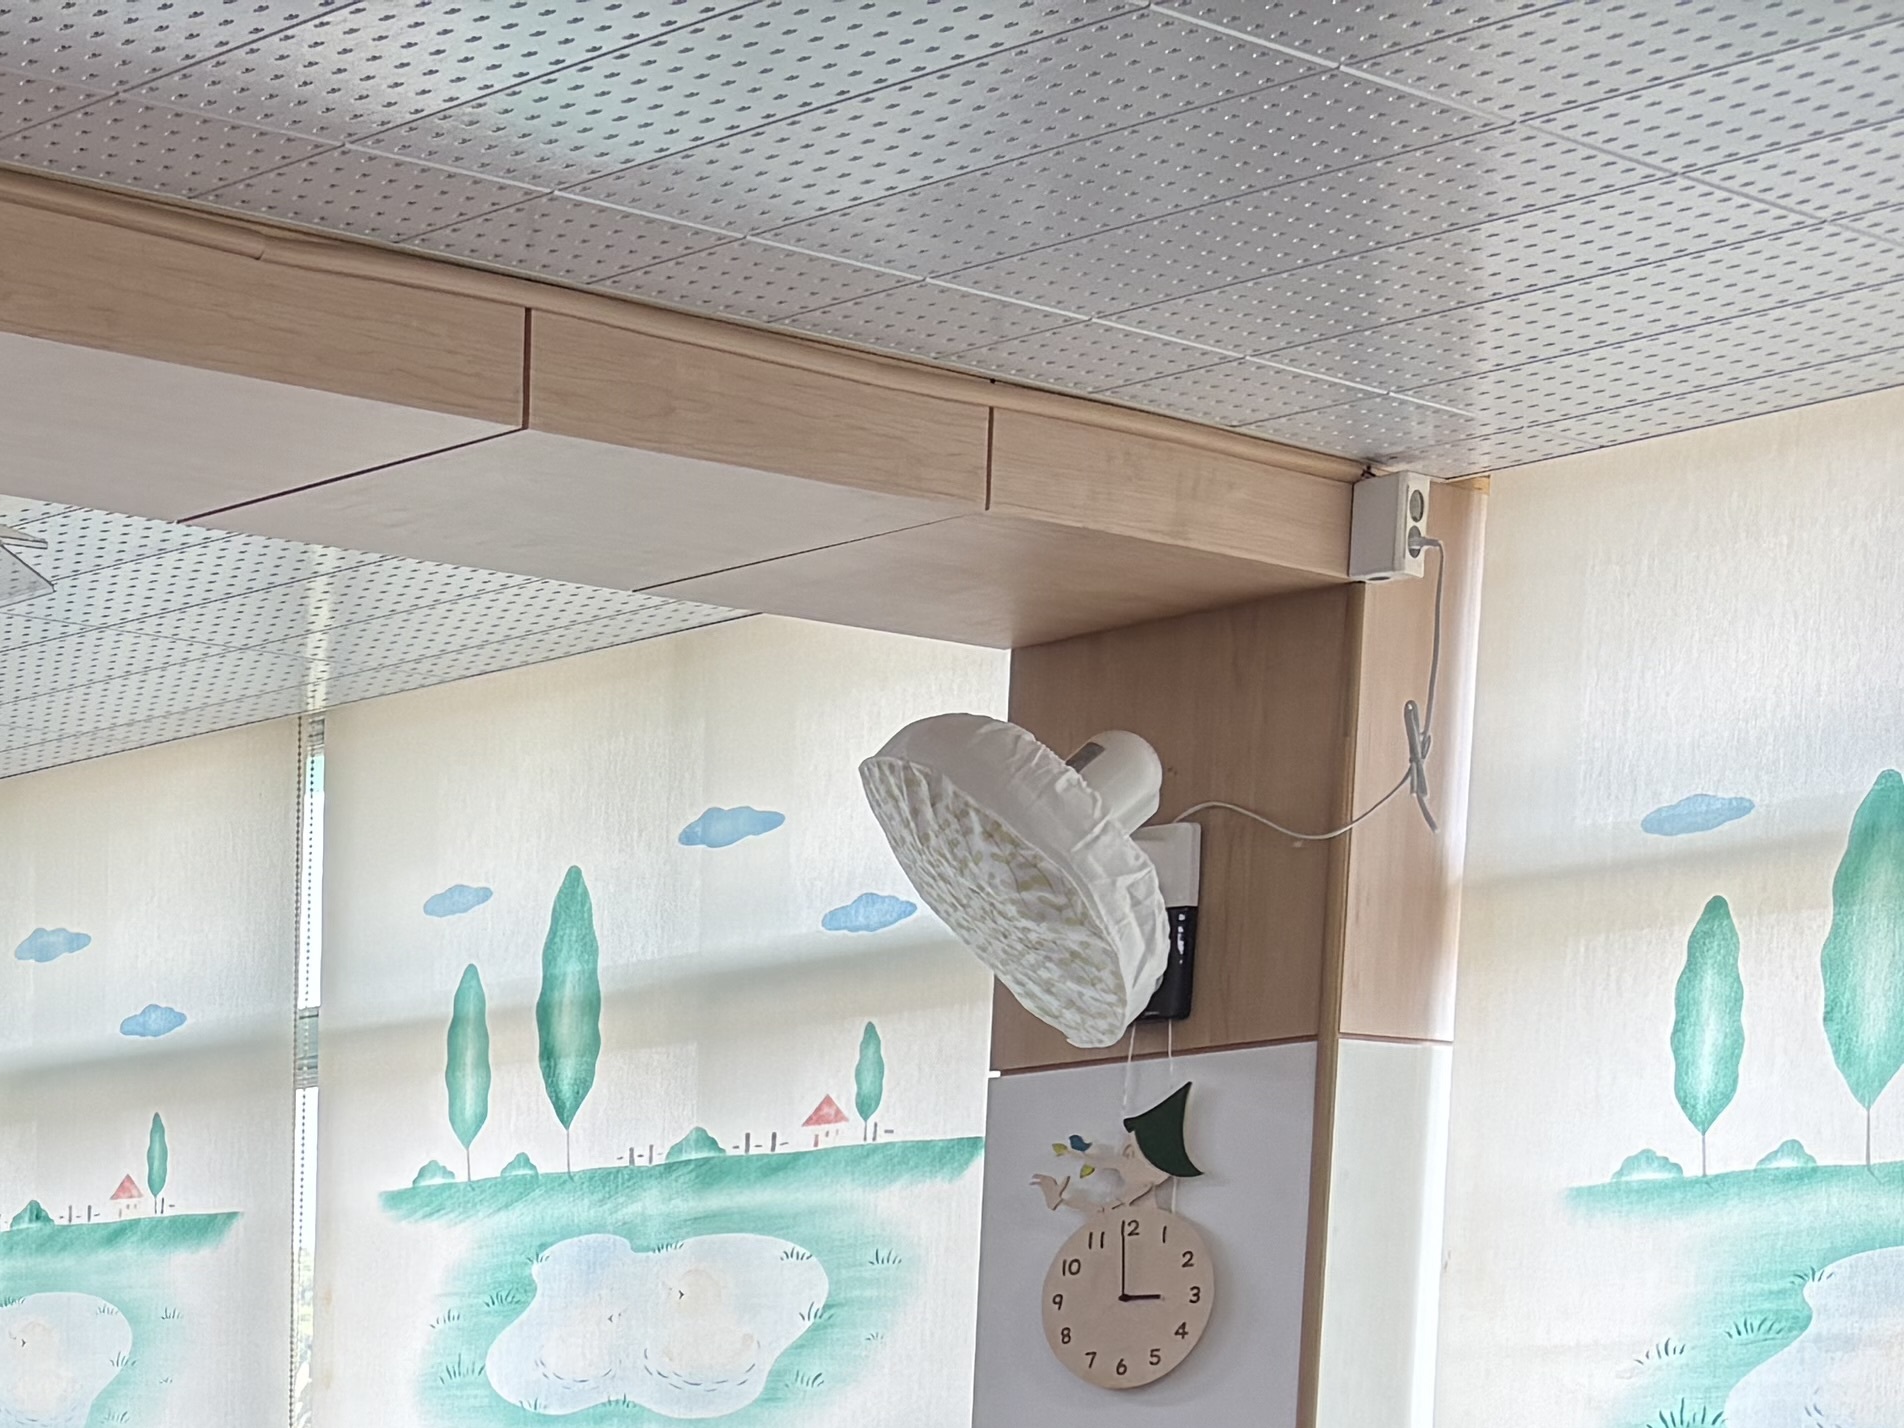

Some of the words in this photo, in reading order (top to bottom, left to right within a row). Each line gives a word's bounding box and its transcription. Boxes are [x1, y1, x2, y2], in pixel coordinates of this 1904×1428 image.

[1088, 1231, 1105, 1250] 11
[1162, 1225, 1167, 1244] 1
[1062, 1258, 1082, 1276] 10
[1181, 1250, 1195, 1268] 2
[1052, 1293, 1064, 1311] 9
[1188, 1286, 1201, 1304] 3
[1060, 1327, 1072, 1345] 8
[1174, 1321, 1189, 1340] 4
[1085, 1351, 1097, 1369] 7
[1149, 1348, 1162, 1366] 5
[1115, 1358, 1128, 1376] 6
